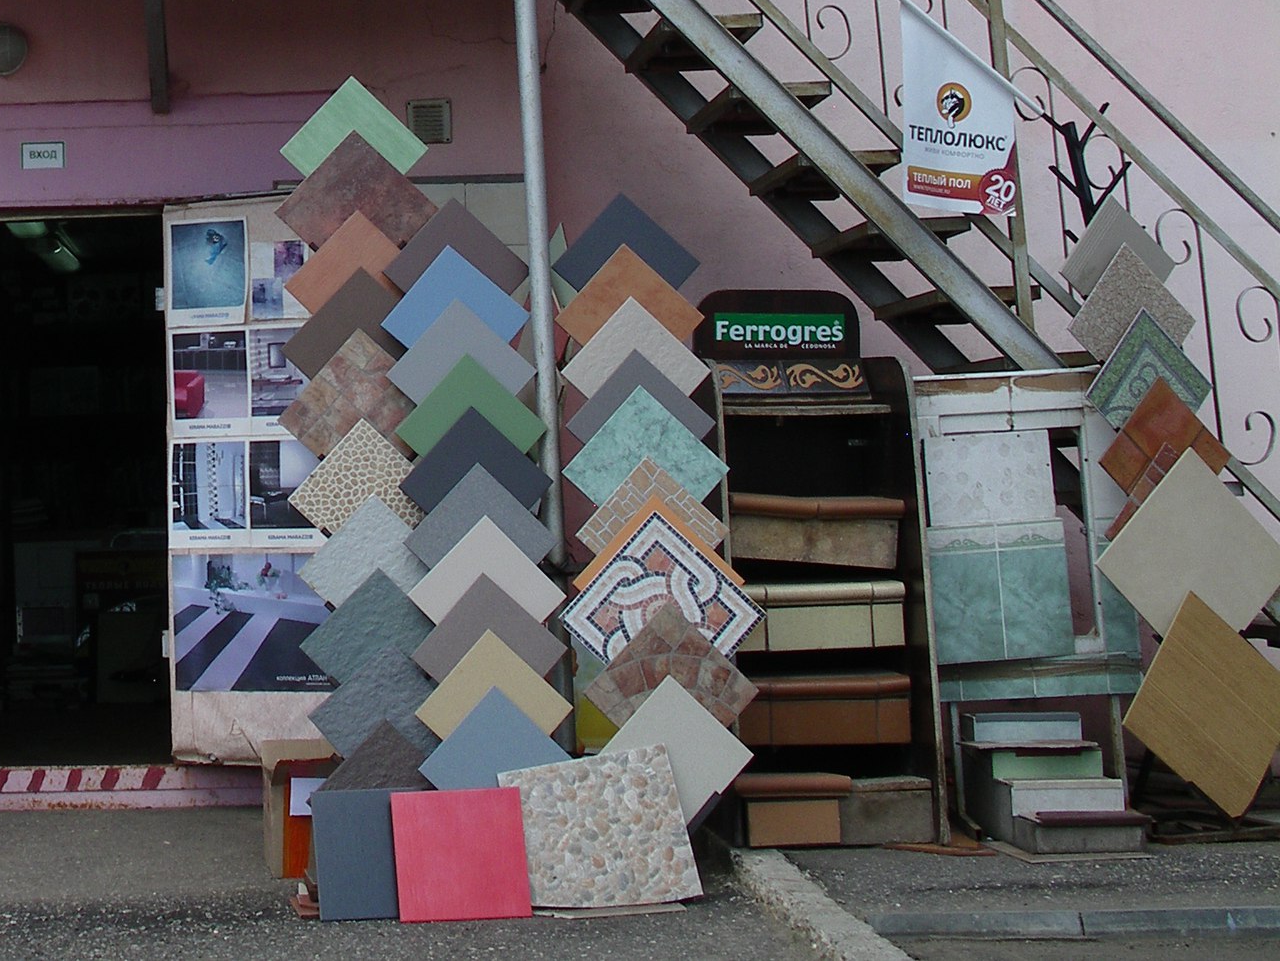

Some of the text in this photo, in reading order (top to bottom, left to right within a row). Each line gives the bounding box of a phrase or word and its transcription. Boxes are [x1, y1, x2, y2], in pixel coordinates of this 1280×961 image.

[909, 124, 1006, 151] ТЕПЛОЛЮКС
[29, 150, 57, 159] ВХОД
[912, 171, 971, 189] ТЕПЛЫЙ ПОЛ
[985, 174, 1016, 203] 20
[986, 195, 1006, 209] ЛЕТ
[715, 320, 844, 345] Ferrogres
